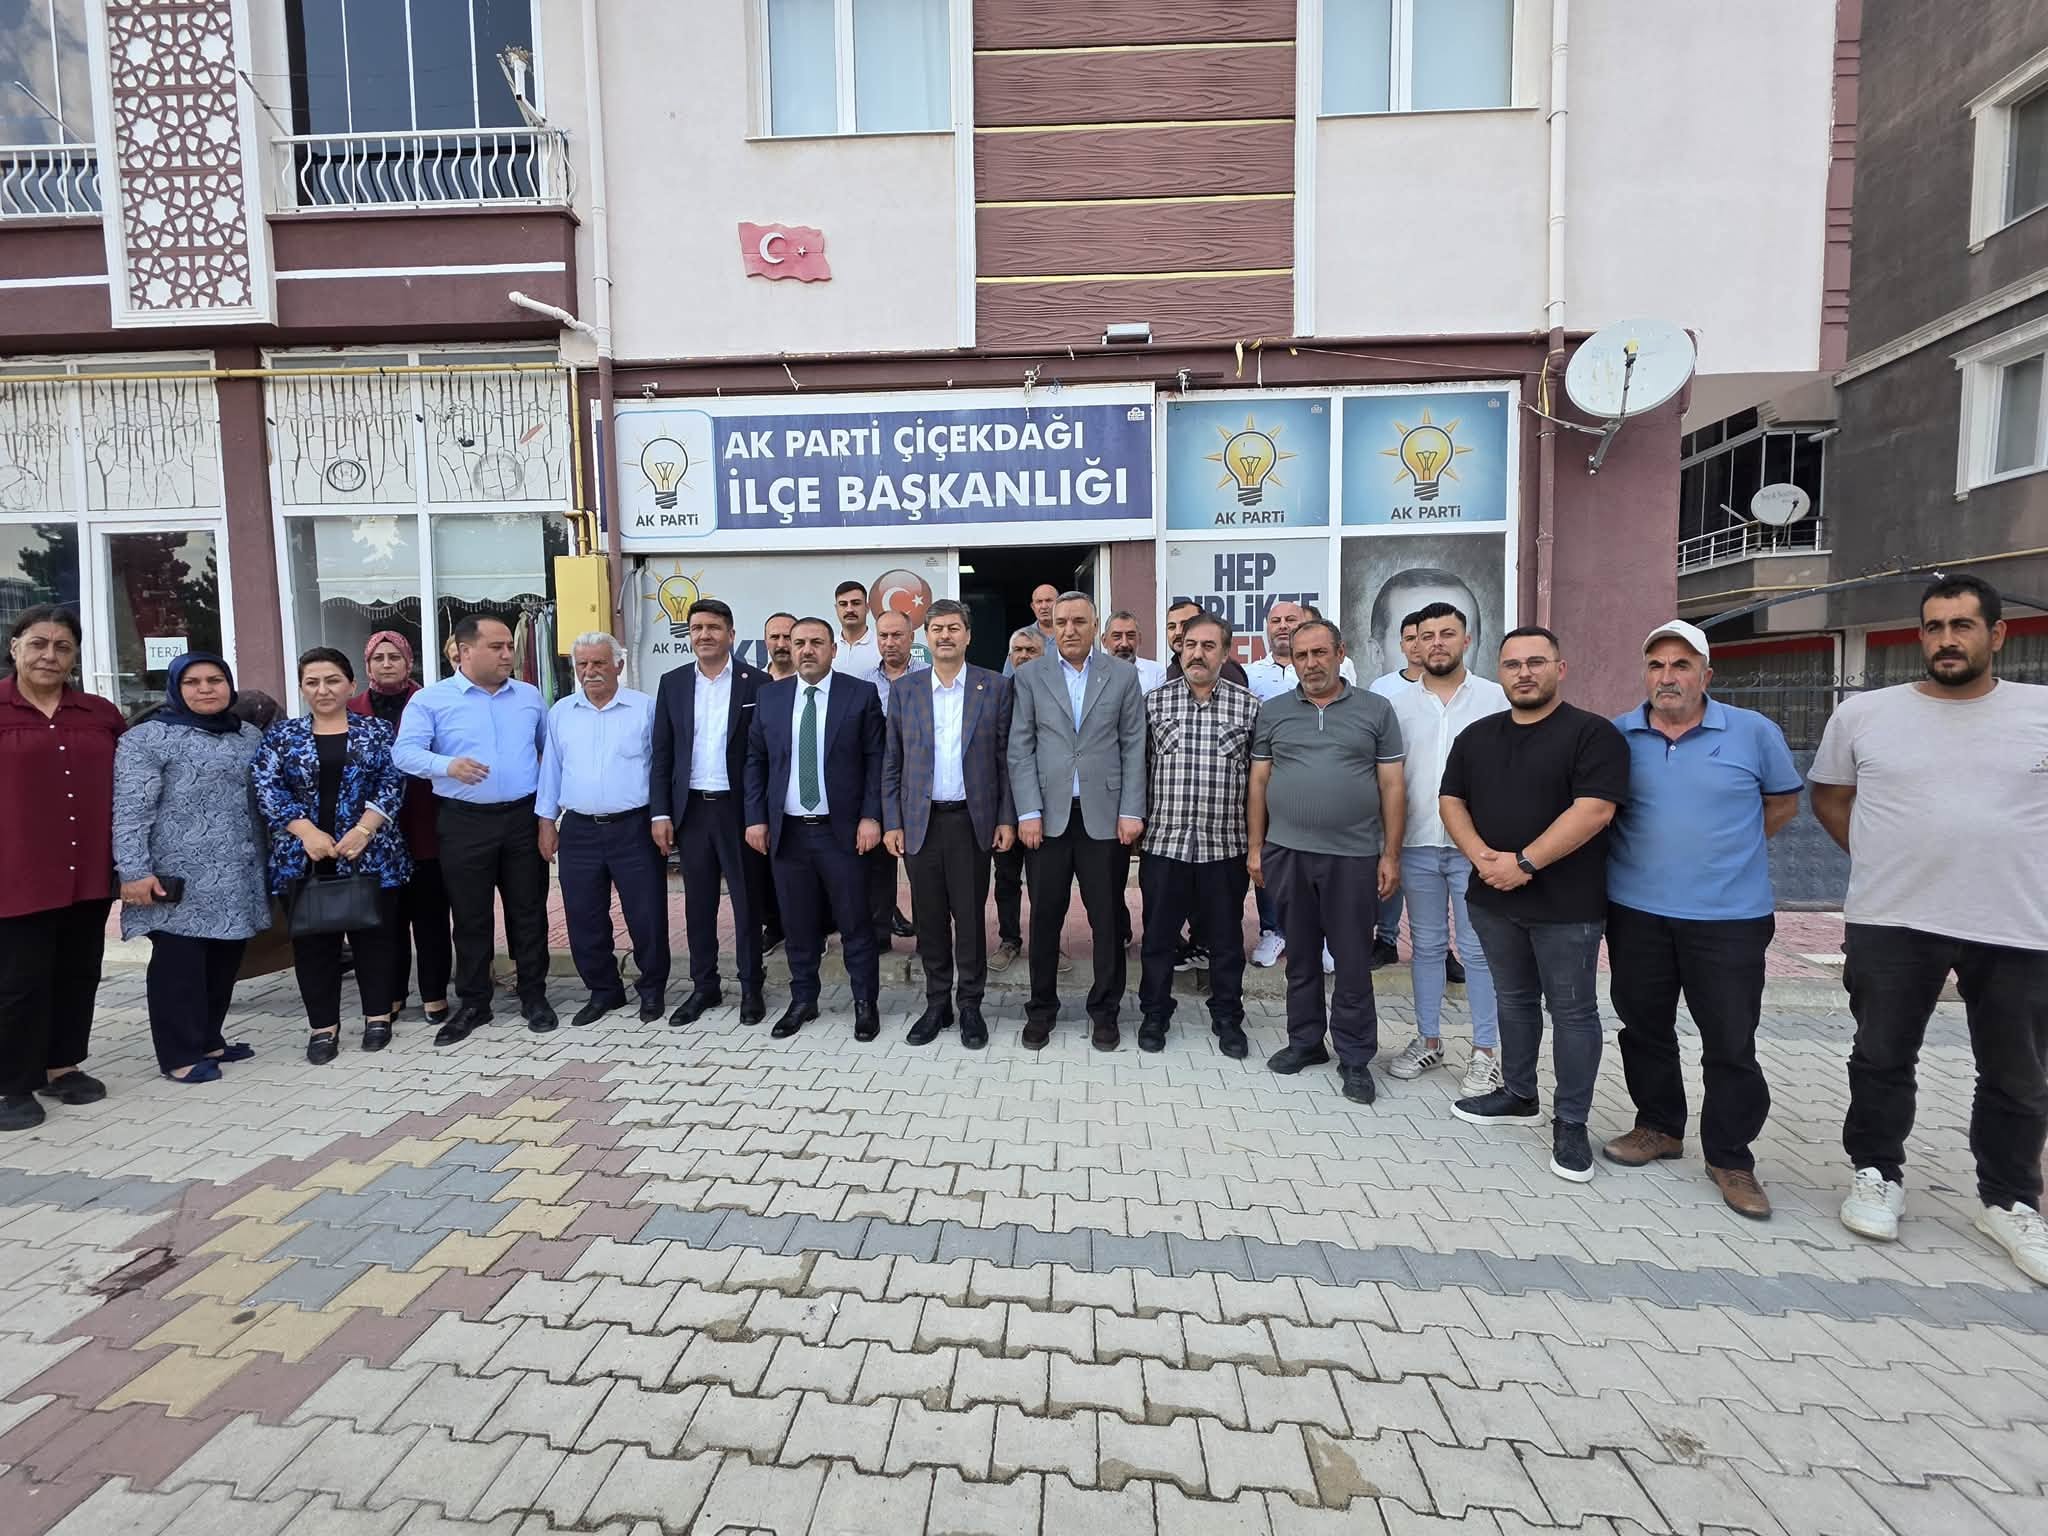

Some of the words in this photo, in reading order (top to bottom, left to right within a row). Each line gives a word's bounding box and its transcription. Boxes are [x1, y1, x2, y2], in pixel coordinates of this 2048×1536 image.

[725, 430, 773, 458] AK
[786, 420, 880, 457] PARTİ
[893, 413, 1083, 462] ÇİÇEKDAĞI
[729, 468, 821, 524] İLÇE
[838, 457, 1127, 520] BAŞKANLIĞI
[1214, 513, 1236, 525] AK
[1390, 508, 1412, 520] AK
[636, 515, 654, 527] AK
[1214, 552, 1276, 592] HEP
[653, 643, 669, 653] AK
